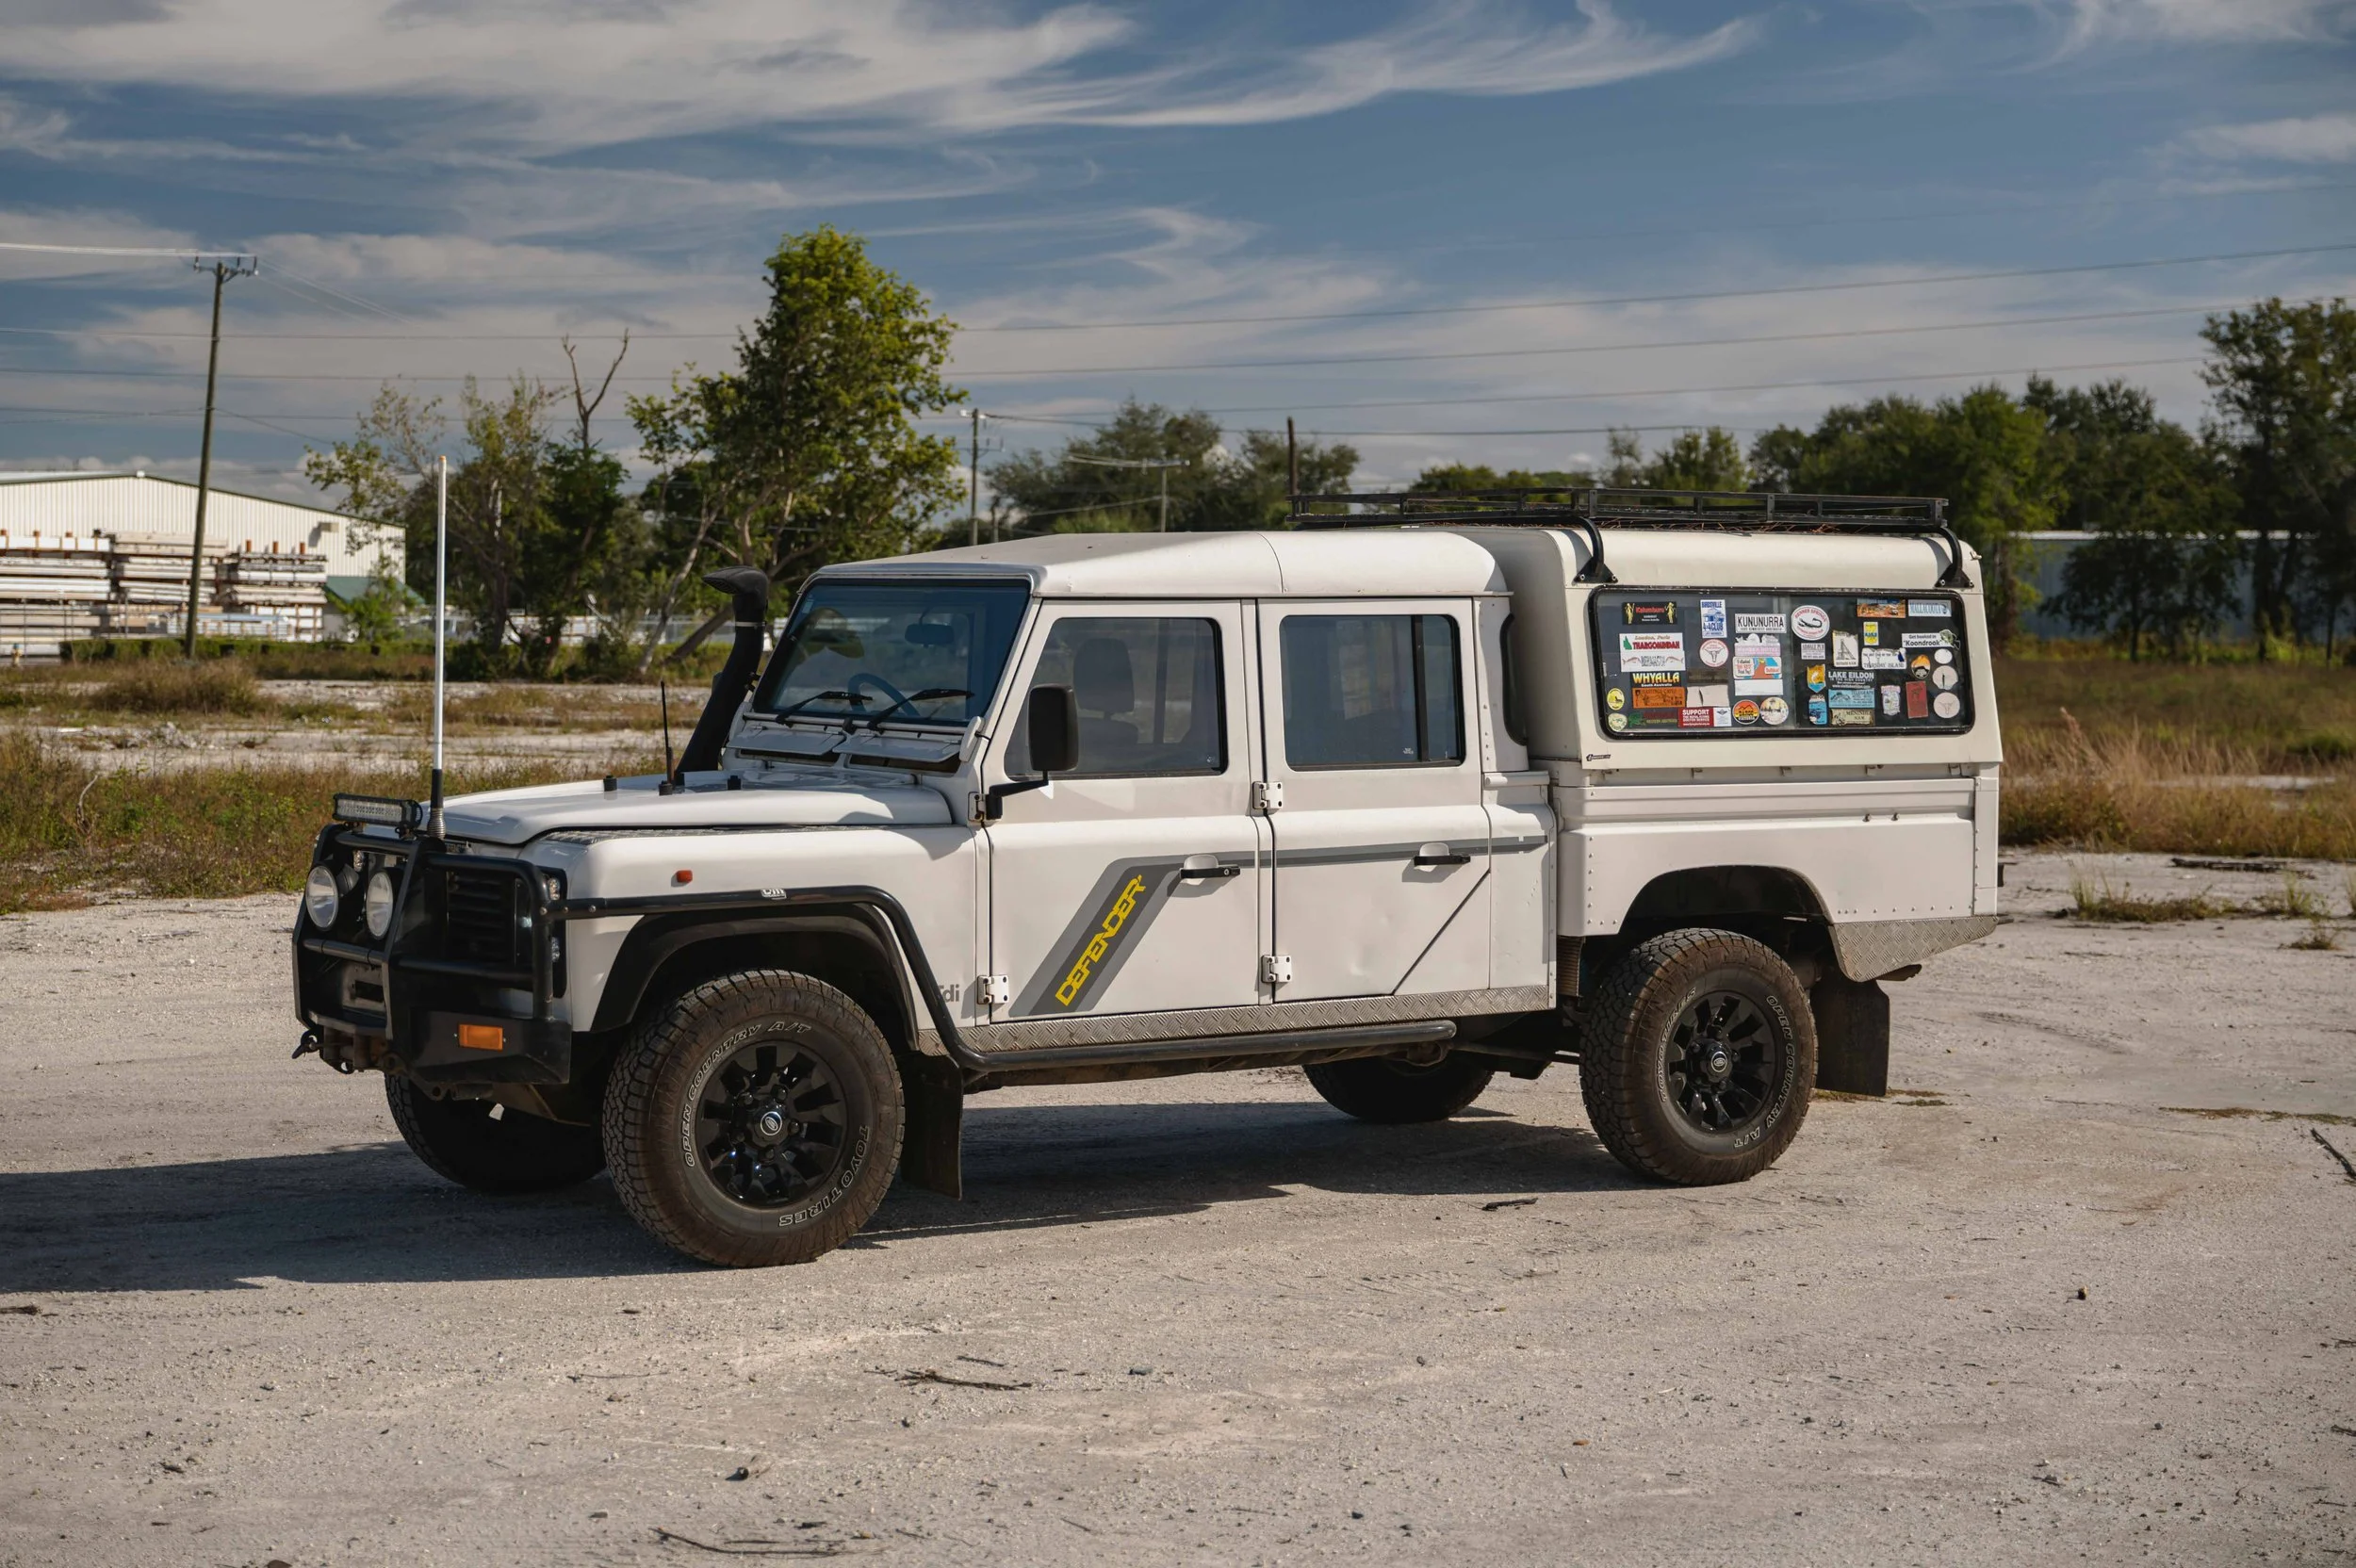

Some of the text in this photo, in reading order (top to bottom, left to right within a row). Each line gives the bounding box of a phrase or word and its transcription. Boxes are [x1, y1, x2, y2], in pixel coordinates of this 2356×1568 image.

[1737, 616, 1784, 628] KUNUNURRA
[1632, 672, 1679, 683] WHYALLA
[1848, 671, 1874, 679] EILDON
[1055, 874, 1147, 1006] DEFENDER
[681, 1021, 812, 1168] OPEN COUNTRY A/T
[1656, 1045, 1668, 1103] TOYO
[1734, 995, 1795, 1149] OPEN COUNTRY A/T
[778, 1125, 871, 1228] TOYO TIRES
